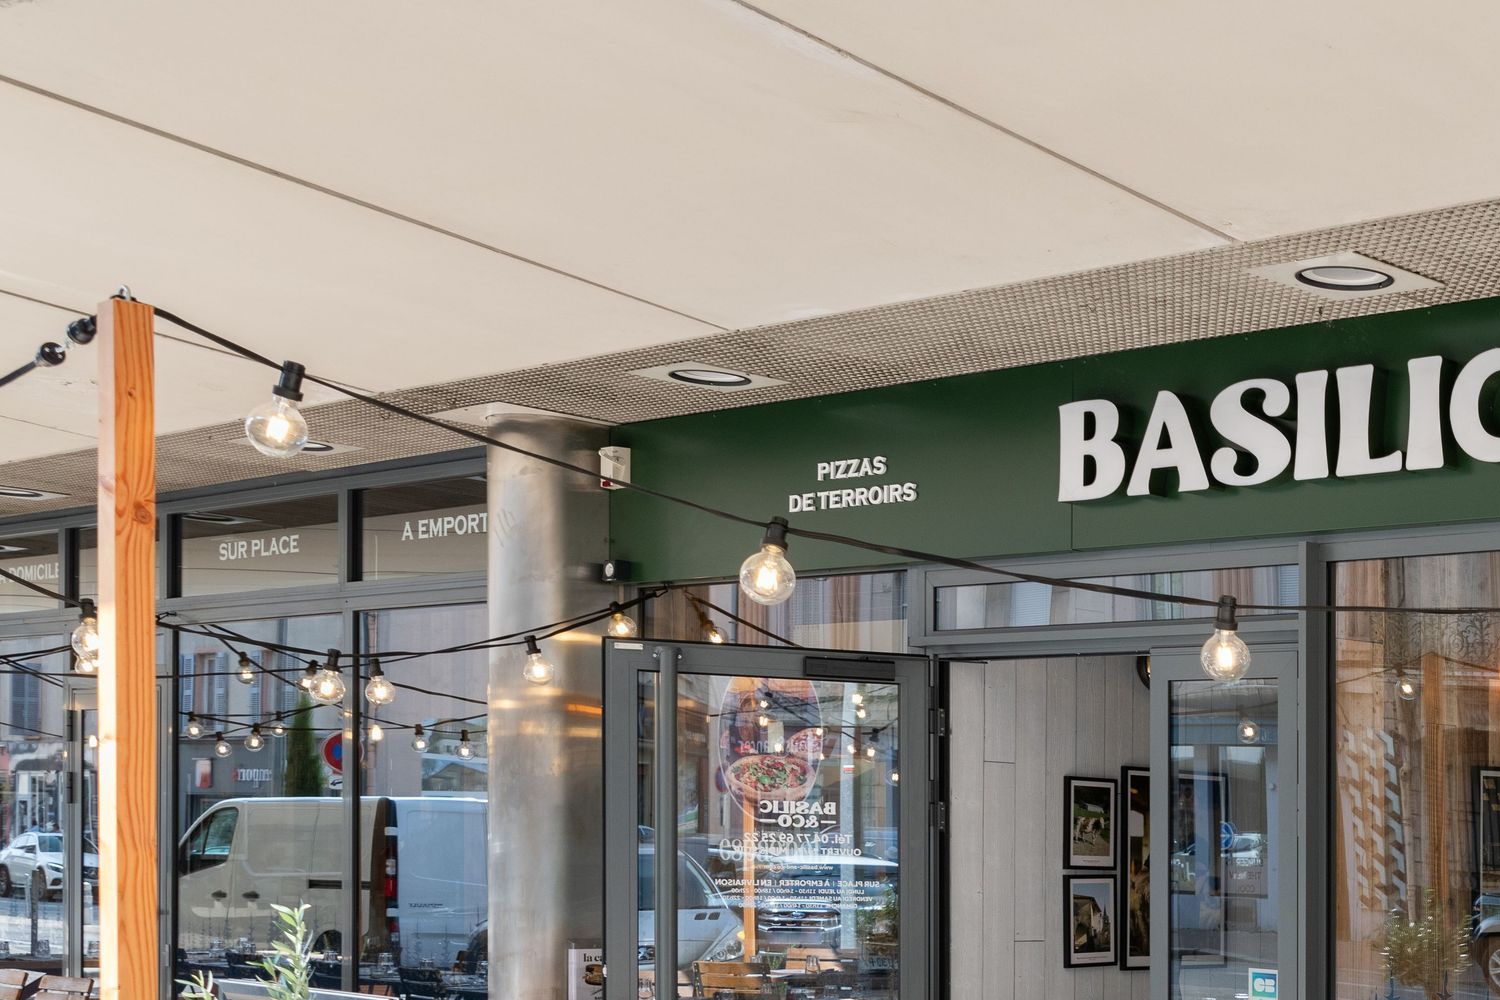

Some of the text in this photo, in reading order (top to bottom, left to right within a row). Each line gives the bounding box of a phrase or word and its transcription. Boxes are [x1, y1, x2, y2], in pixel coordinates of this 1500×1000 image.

[817, 455, 887, 481] PIZZAS
[788, 482, 918, 513] DE TERROIRS
[401, 521, 414, 541] A
[218, 534, 300, 561] SUR PLACE
